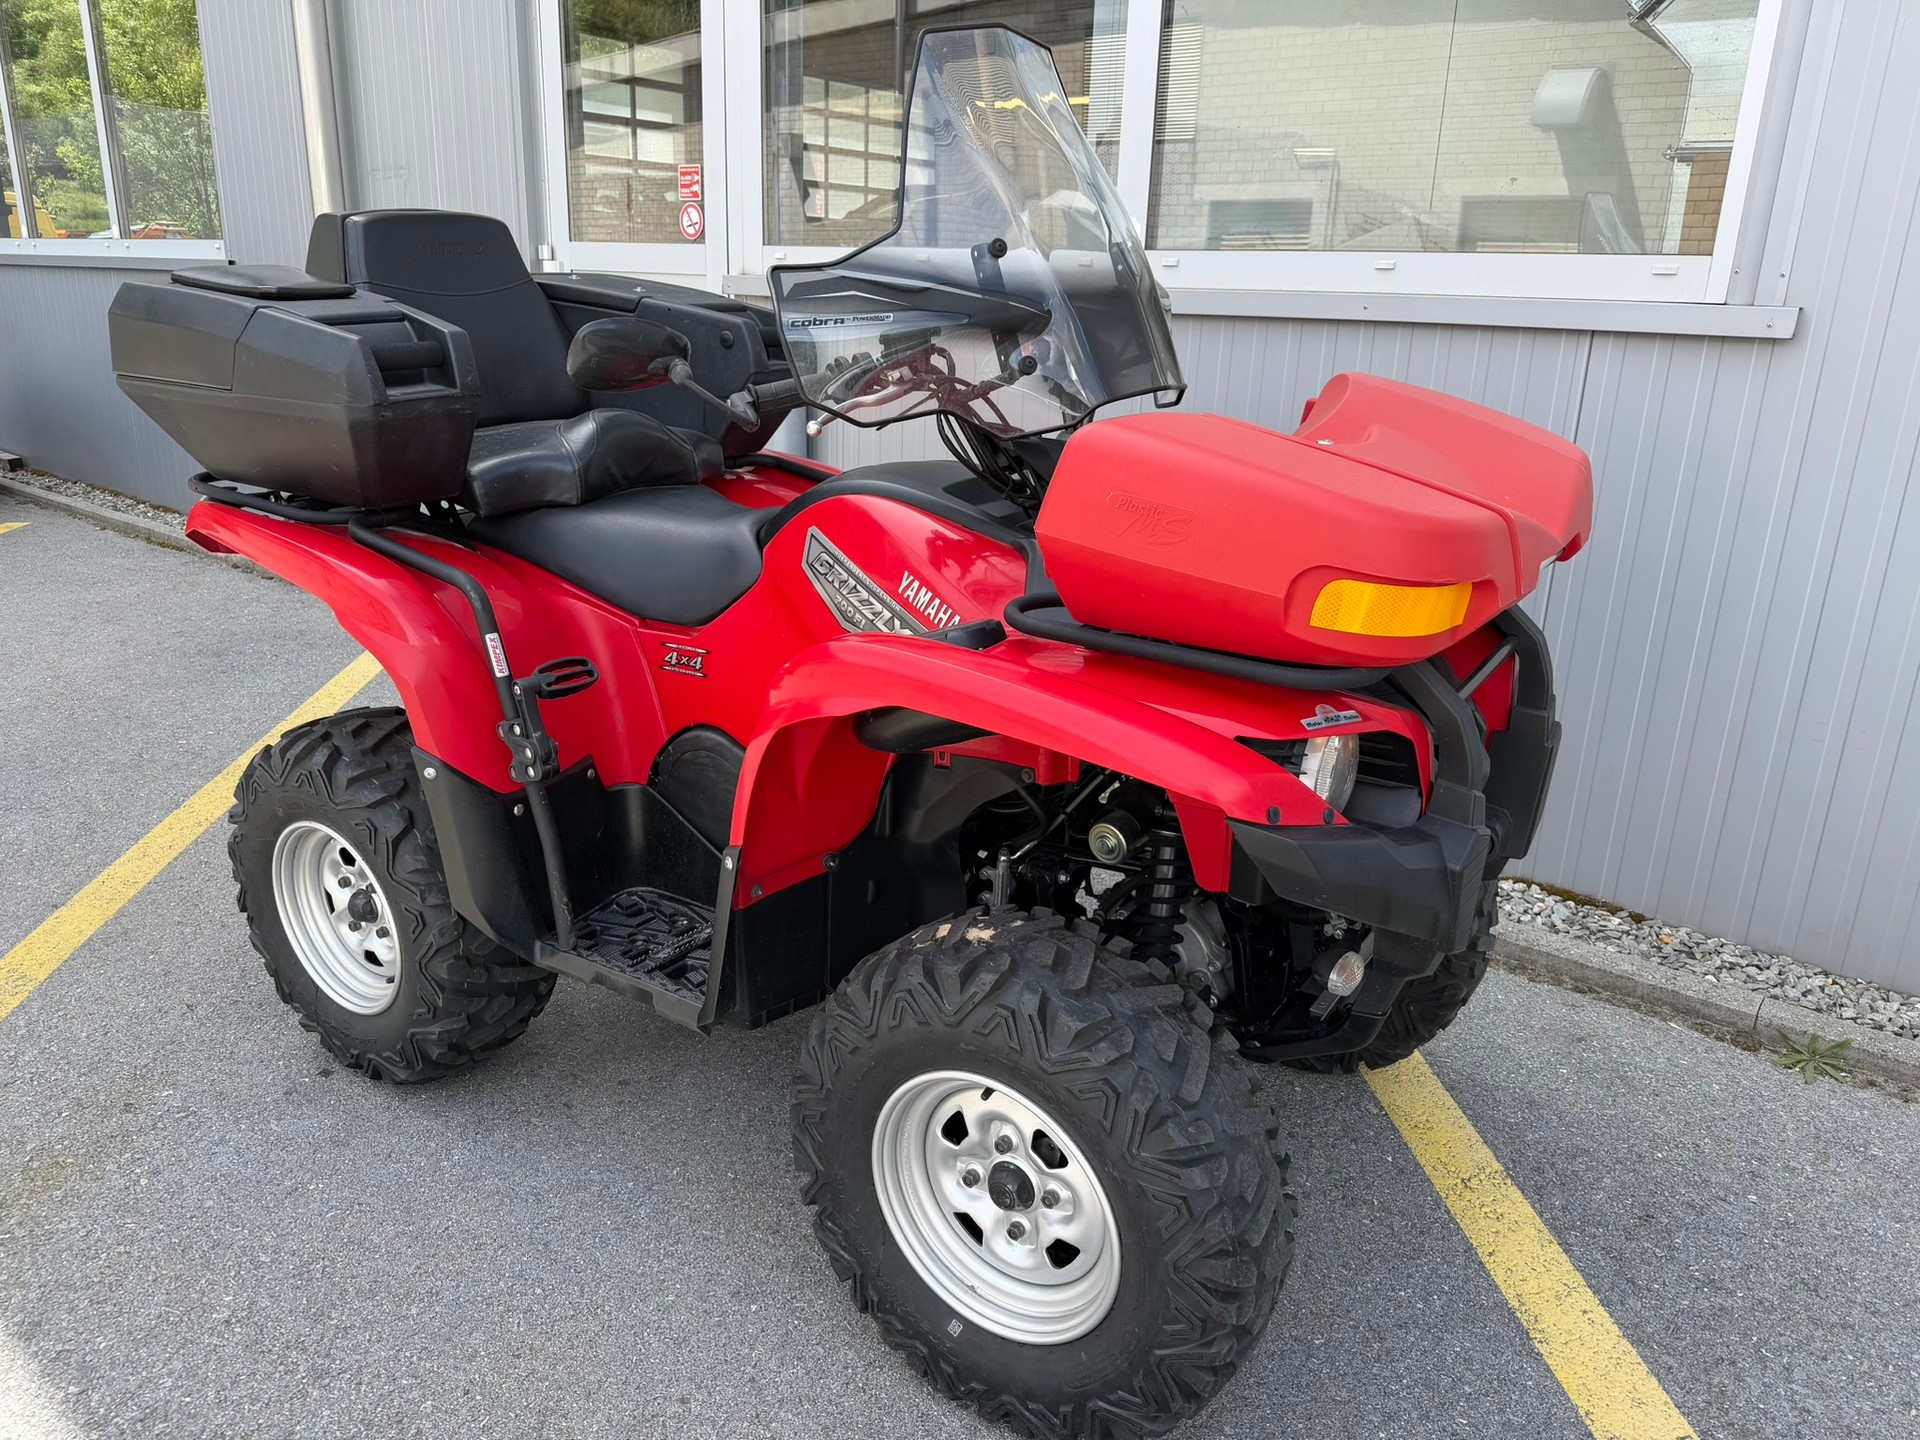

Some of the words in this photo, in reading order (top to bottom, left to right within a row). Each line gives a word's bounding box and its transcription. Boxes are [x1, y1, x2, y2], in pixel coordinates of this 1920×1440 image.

[790, 317, 845, 328] cobra
[1115, 496, 1164, 517] Plastic
[488, 636, 505, 674] KIMPEX
[664, 651, 703, 670] 4x4
